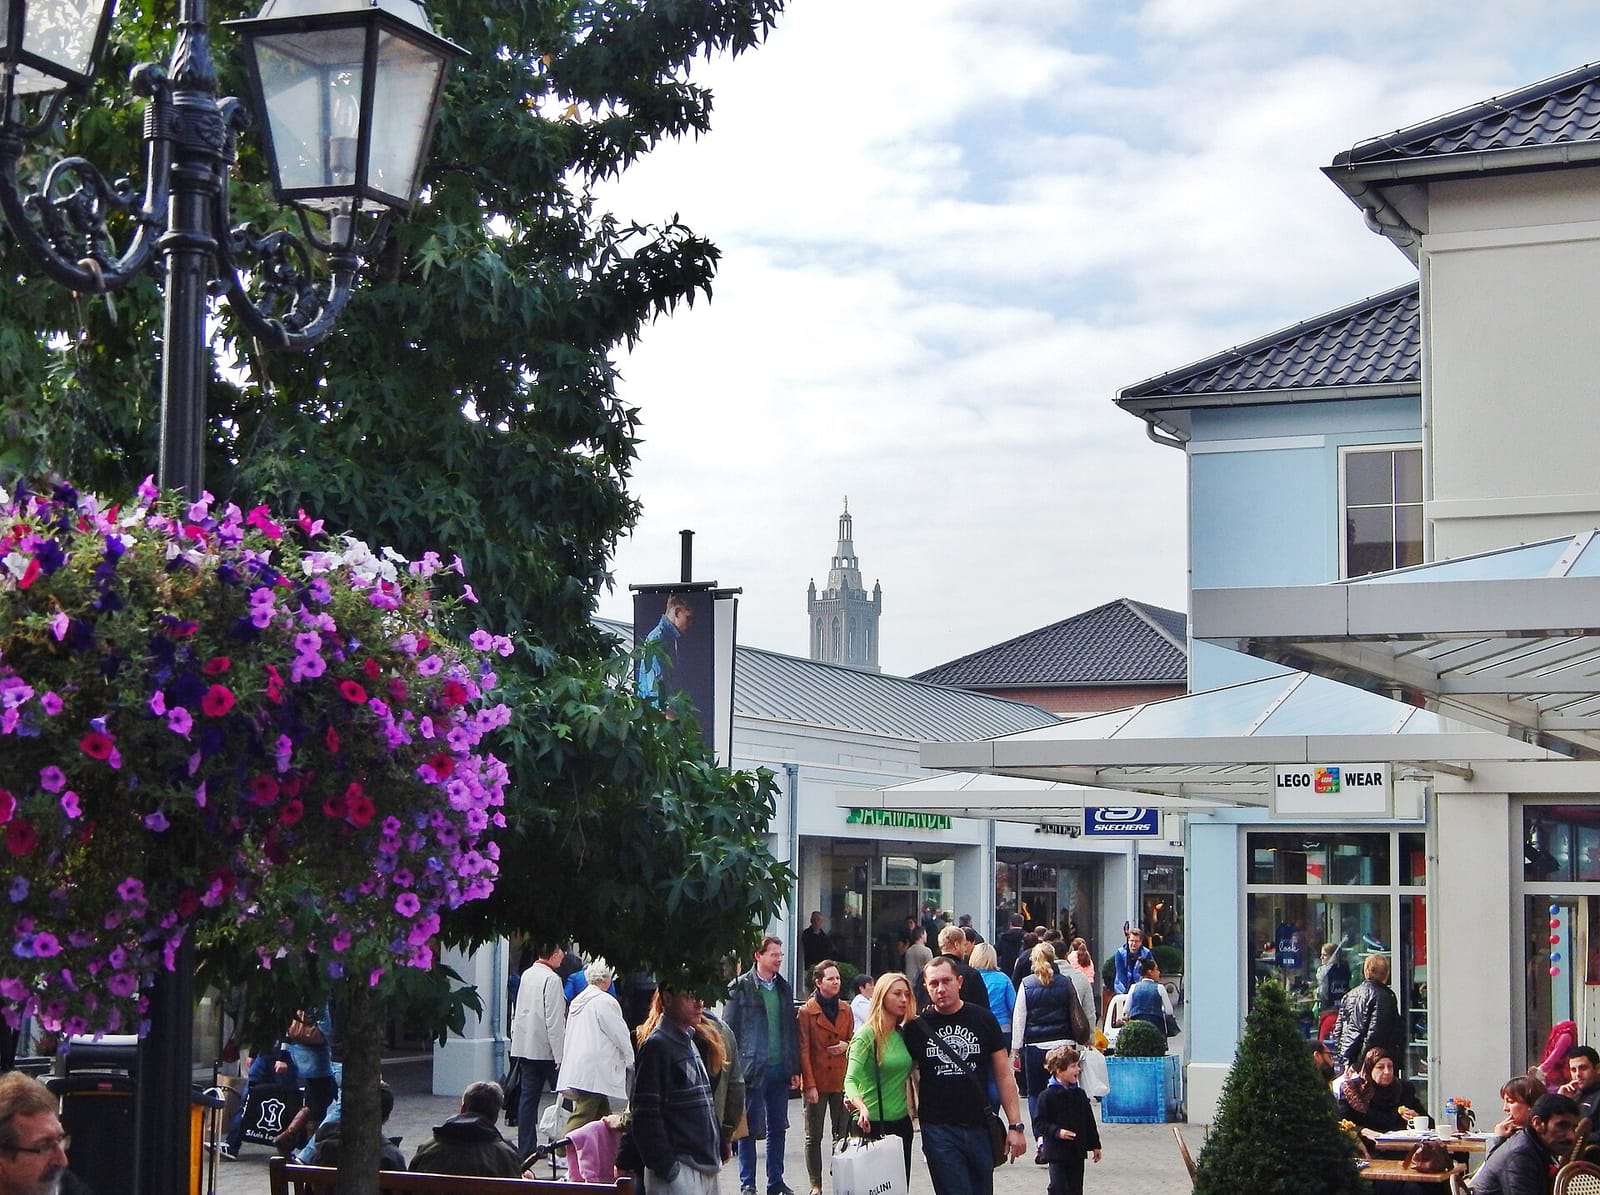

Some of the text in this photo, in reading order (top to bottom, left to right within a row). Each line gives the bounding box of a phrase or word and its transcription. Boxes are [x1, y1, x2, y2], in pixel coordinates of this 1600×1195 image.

[1277, 772, 1383, 788] LEGO WEAR
[1093, 823, 1152, 831] SKECHERS
[1279, 940, 1300, 953] look
[954, 1025, 979, 1044] BOSS
